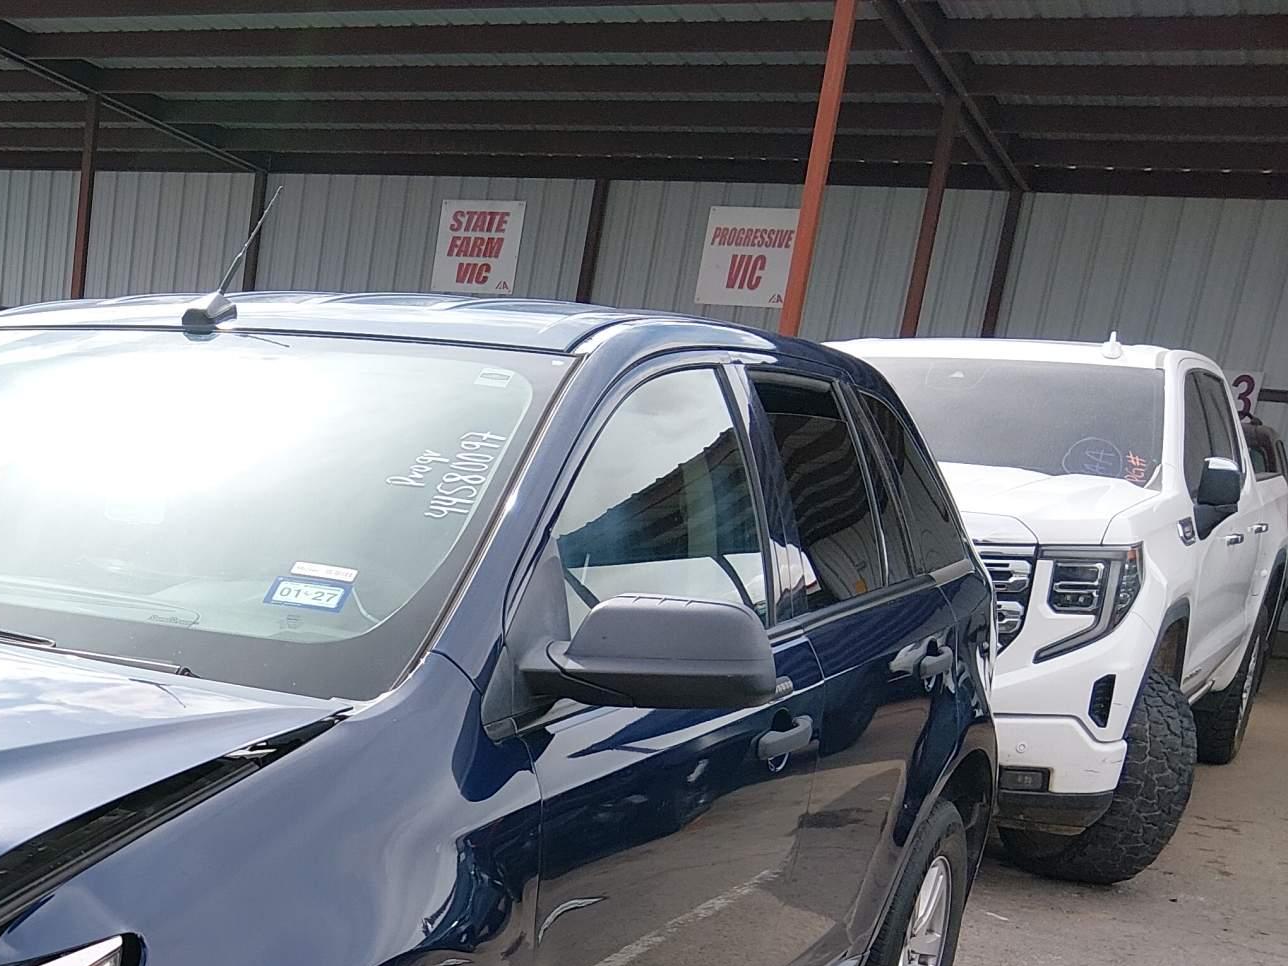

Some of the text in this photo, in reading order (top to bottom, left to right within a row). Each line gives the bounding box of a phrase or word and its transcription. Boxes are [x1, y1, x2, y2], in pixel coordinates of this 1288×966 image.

[449, 210, 510, 232] STATE
[447, 236, 504, 258] FARM
[711, 227, 795, 248] PROGRESSIVE
[456, 262, 491, 284] VIC
[726, 254, 767, 290] VIC
[1232, 374, 1255, 421] 3
[424, 431, 507, 518] 44580097
